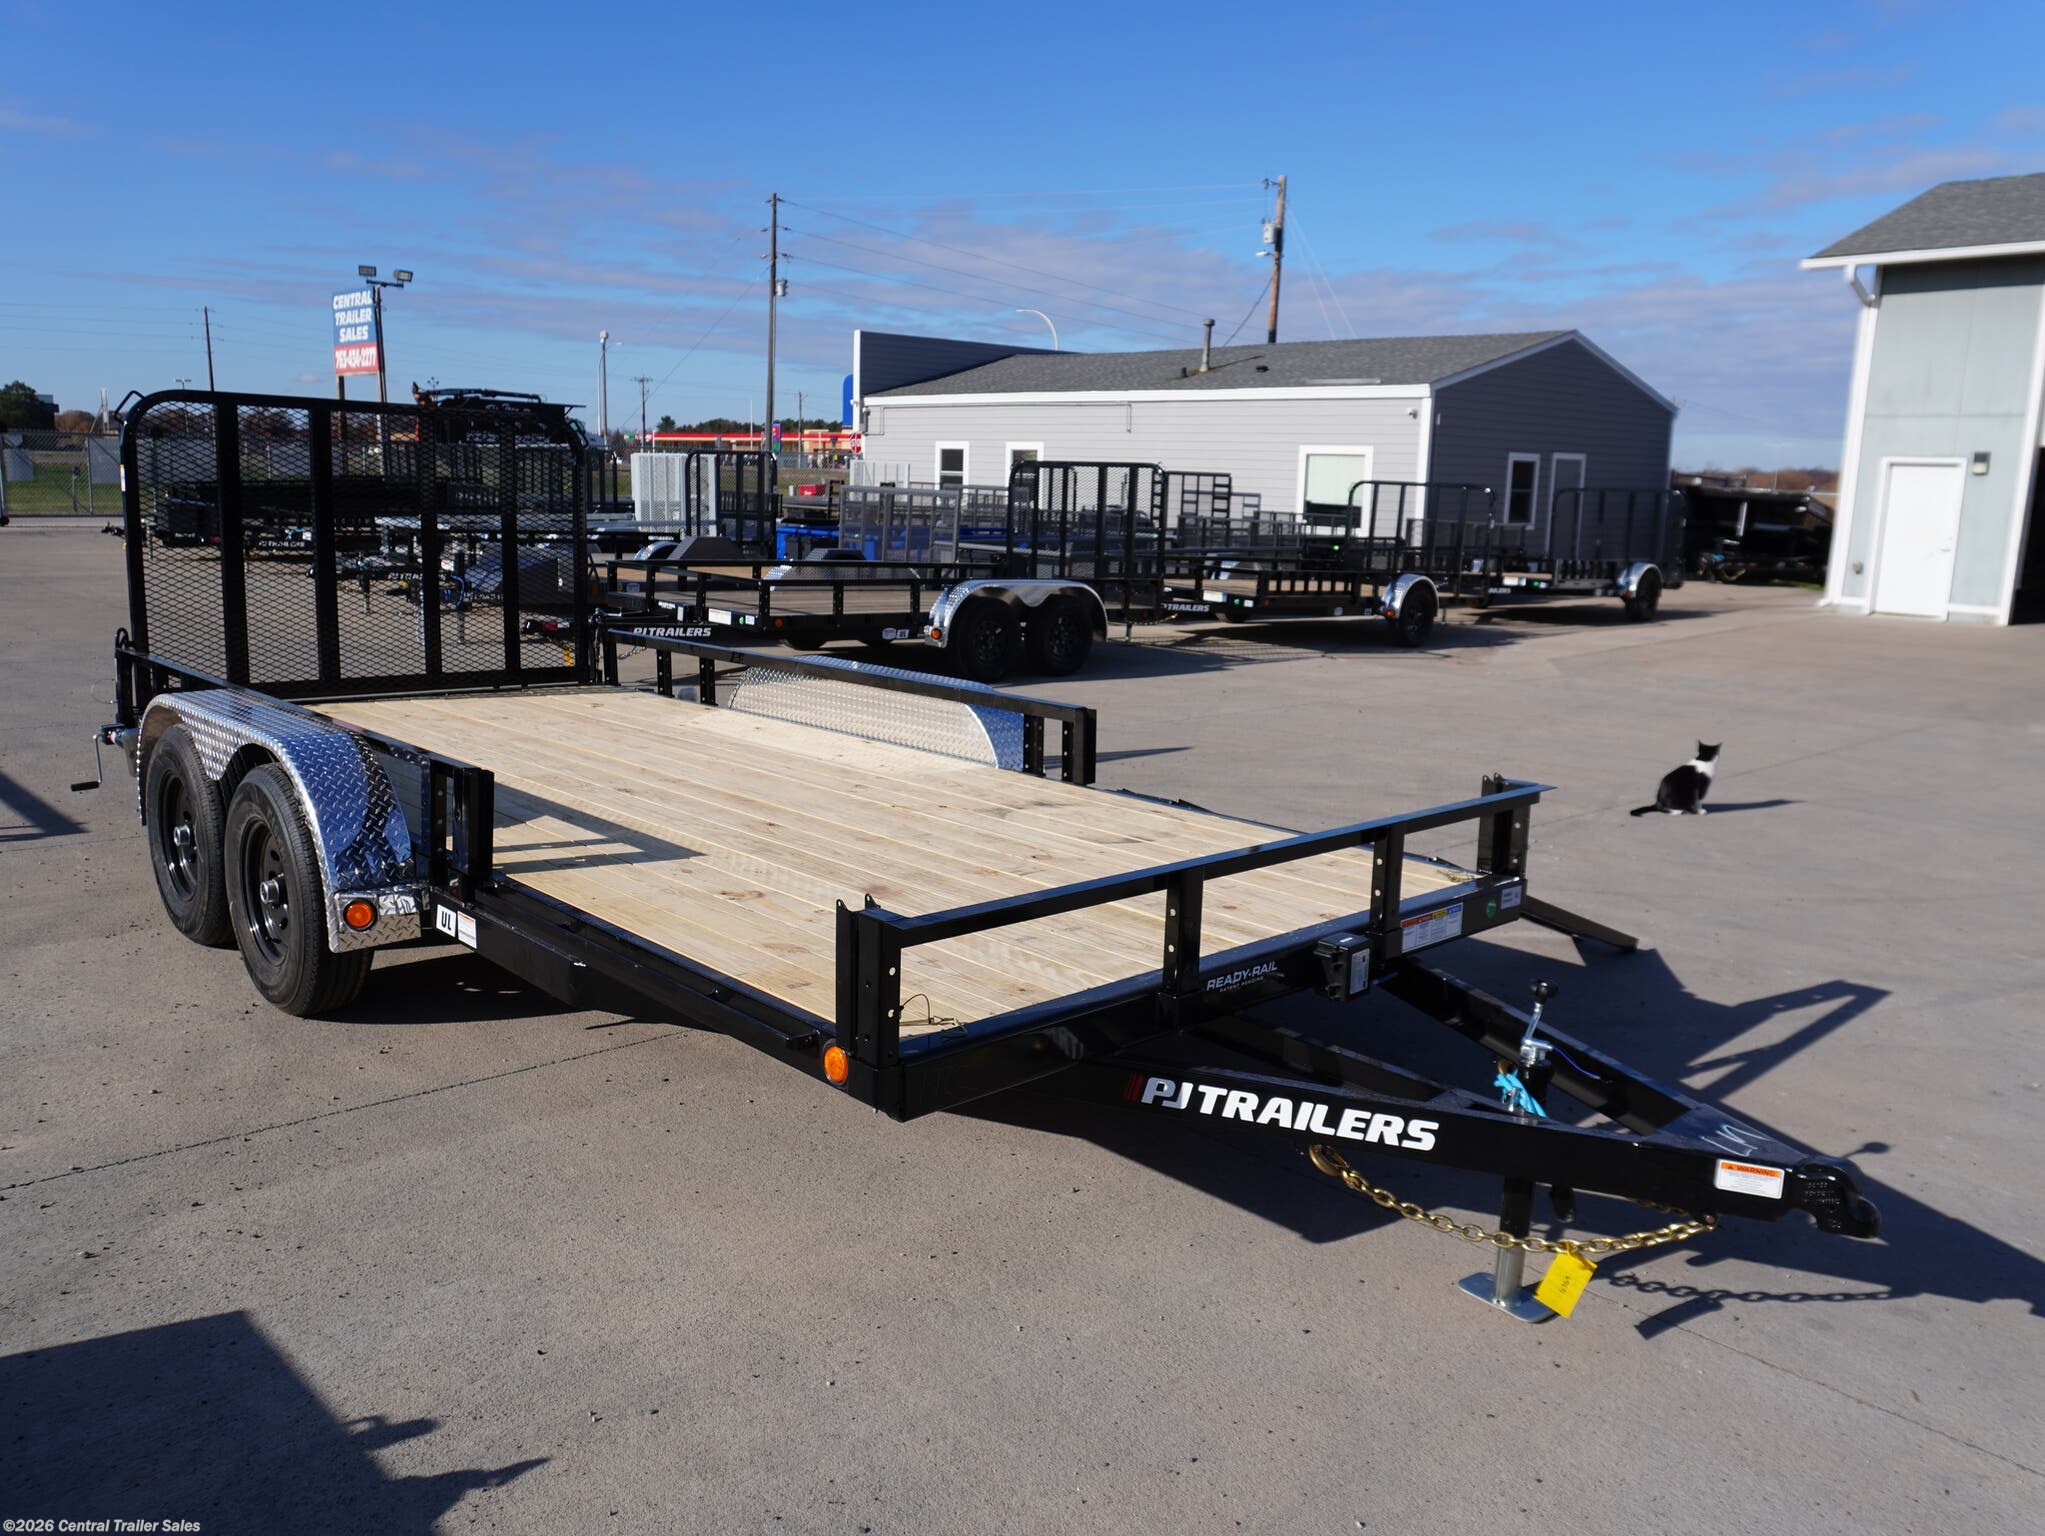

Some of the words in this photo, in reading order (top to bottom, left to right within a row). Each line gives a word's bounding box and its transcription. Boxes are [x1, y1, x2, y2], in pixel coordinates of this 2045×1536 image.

[333, 290, 372, 310] CENTRAL
[335, 307, 372, 326] TRAILER
[339, 325, 369, 343] SALES
[1168, 603, 1210, 612] TRAILERS
[649, 628, 712, 637] TRAILERS
[441, 910, 452, 931] UL
[1206, 961, 1278, 991] READY-RAIL
[1141, 1077, 1194, 1110] PJ
[1198, 1084, 1440, 1151] TRAILERS
[1737, 1165, 1777, 1177] WARNING
